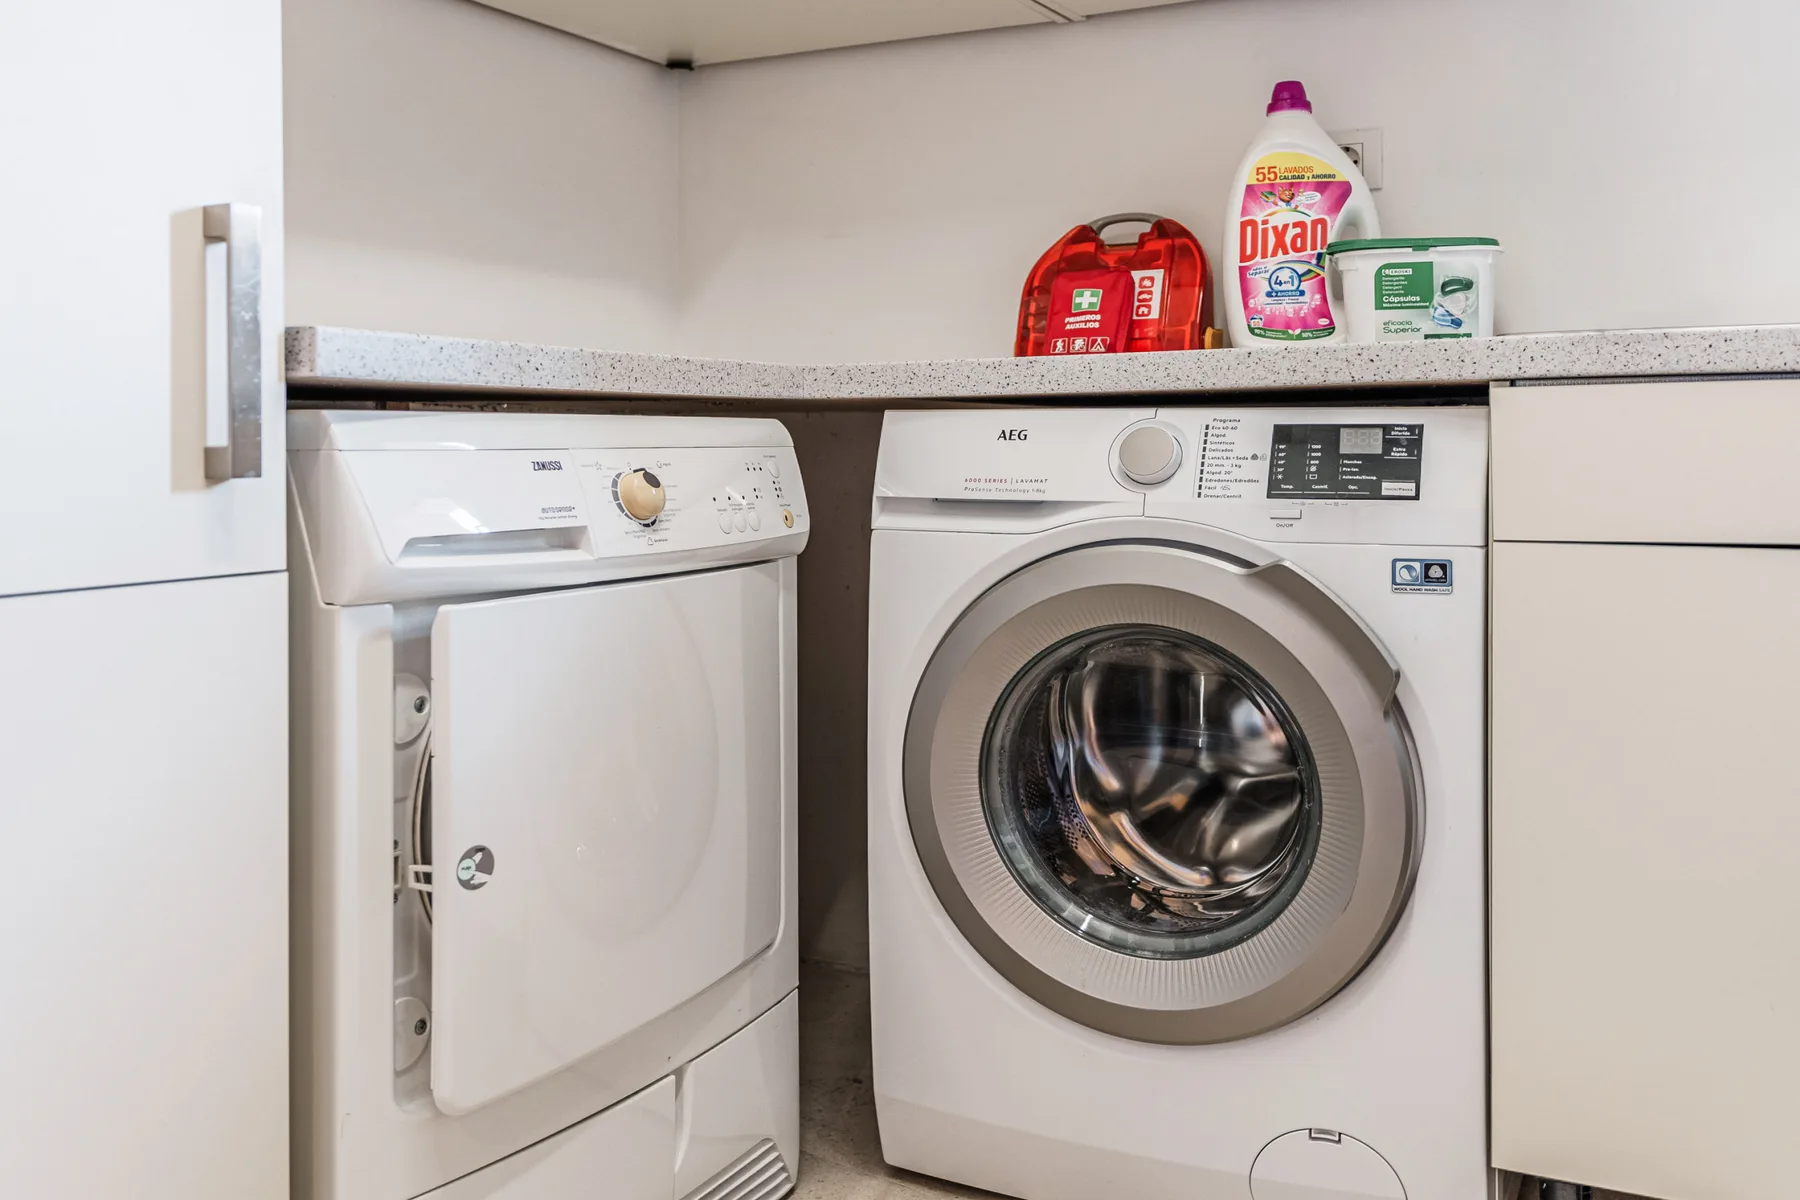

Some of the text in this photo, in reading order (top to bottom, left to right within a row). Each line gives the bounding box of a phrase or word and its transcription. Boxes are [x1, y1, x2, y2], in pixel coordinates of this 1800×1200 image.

[1256, 166, 1314, 182] 55 LAVADOS
[1240, 218, 1328, 263] Dixan
[1064, 313, 1102, 323] PRIMEROS
[1065, 322, 1100, 330] AUXILIOS
[1383, 326, 1422, 335] Superior
[997, 429, 1028, 441] AEG
[531, 460, 563, 471] ZANUSSI
